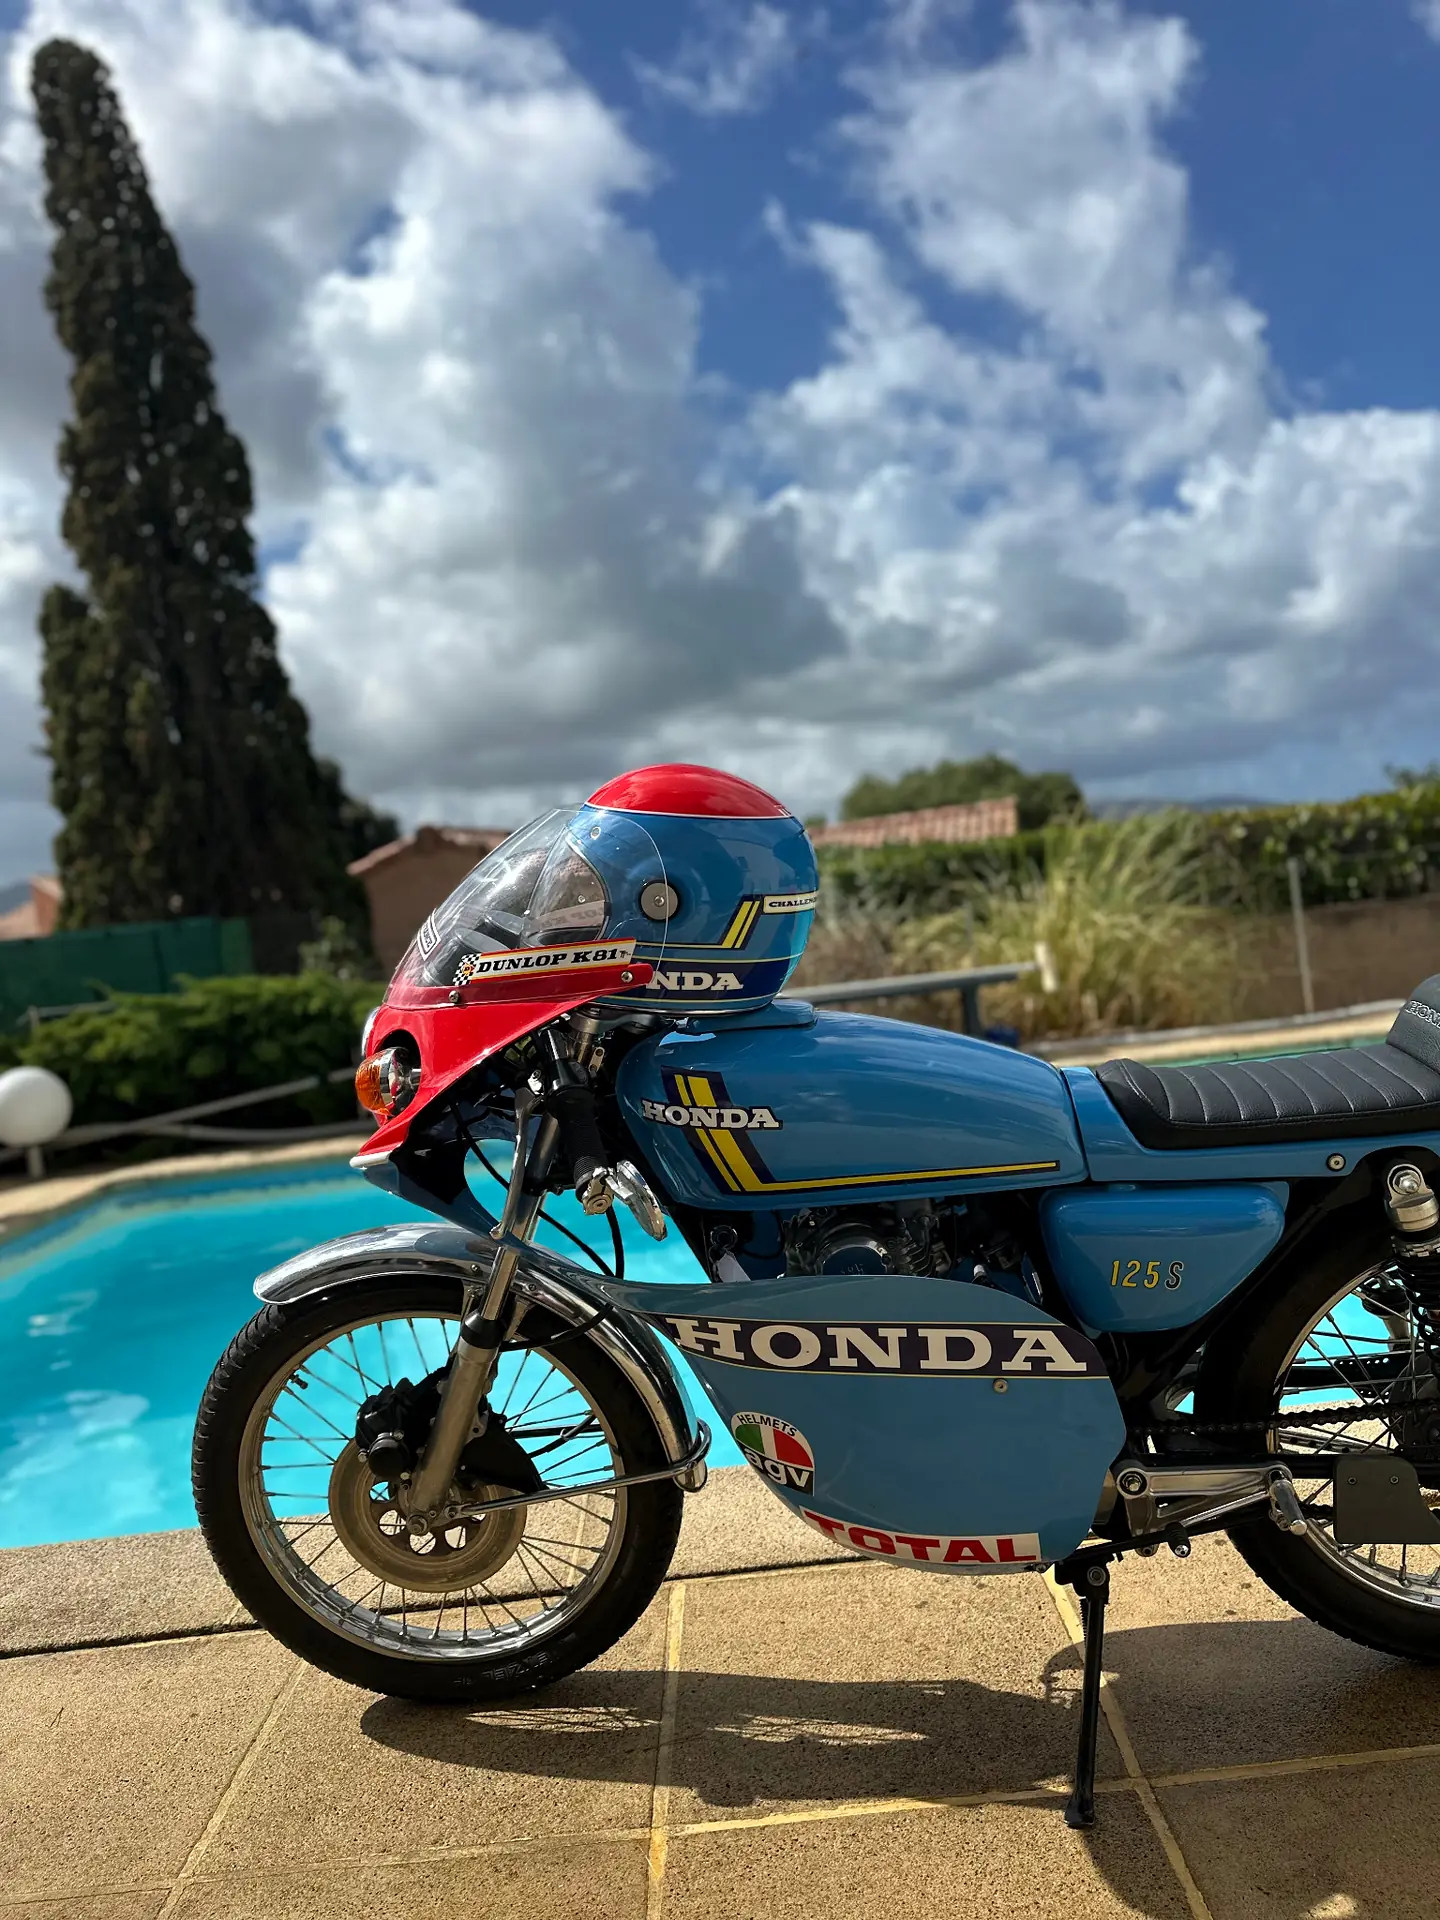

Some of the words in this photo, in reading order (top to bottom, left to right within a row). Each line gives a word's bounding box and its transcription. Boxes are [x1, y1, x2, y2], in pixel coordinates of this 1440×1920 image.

[476, 952, 568, 973] DUNLOP
[571, 948, 618, 963] K81
[646, 970, 744, 991] NDA
[1405, 1000, 1440, 1029] HON
[641, 1099, 779, 1129] HONDA
[665, 1317, 1087, 1372] HONDA
[737, 1414, 797, 1437] HELMETS
[744, 1447, 810, 1488] agv
[803, 1510, 1037, 1563] TOTAL
